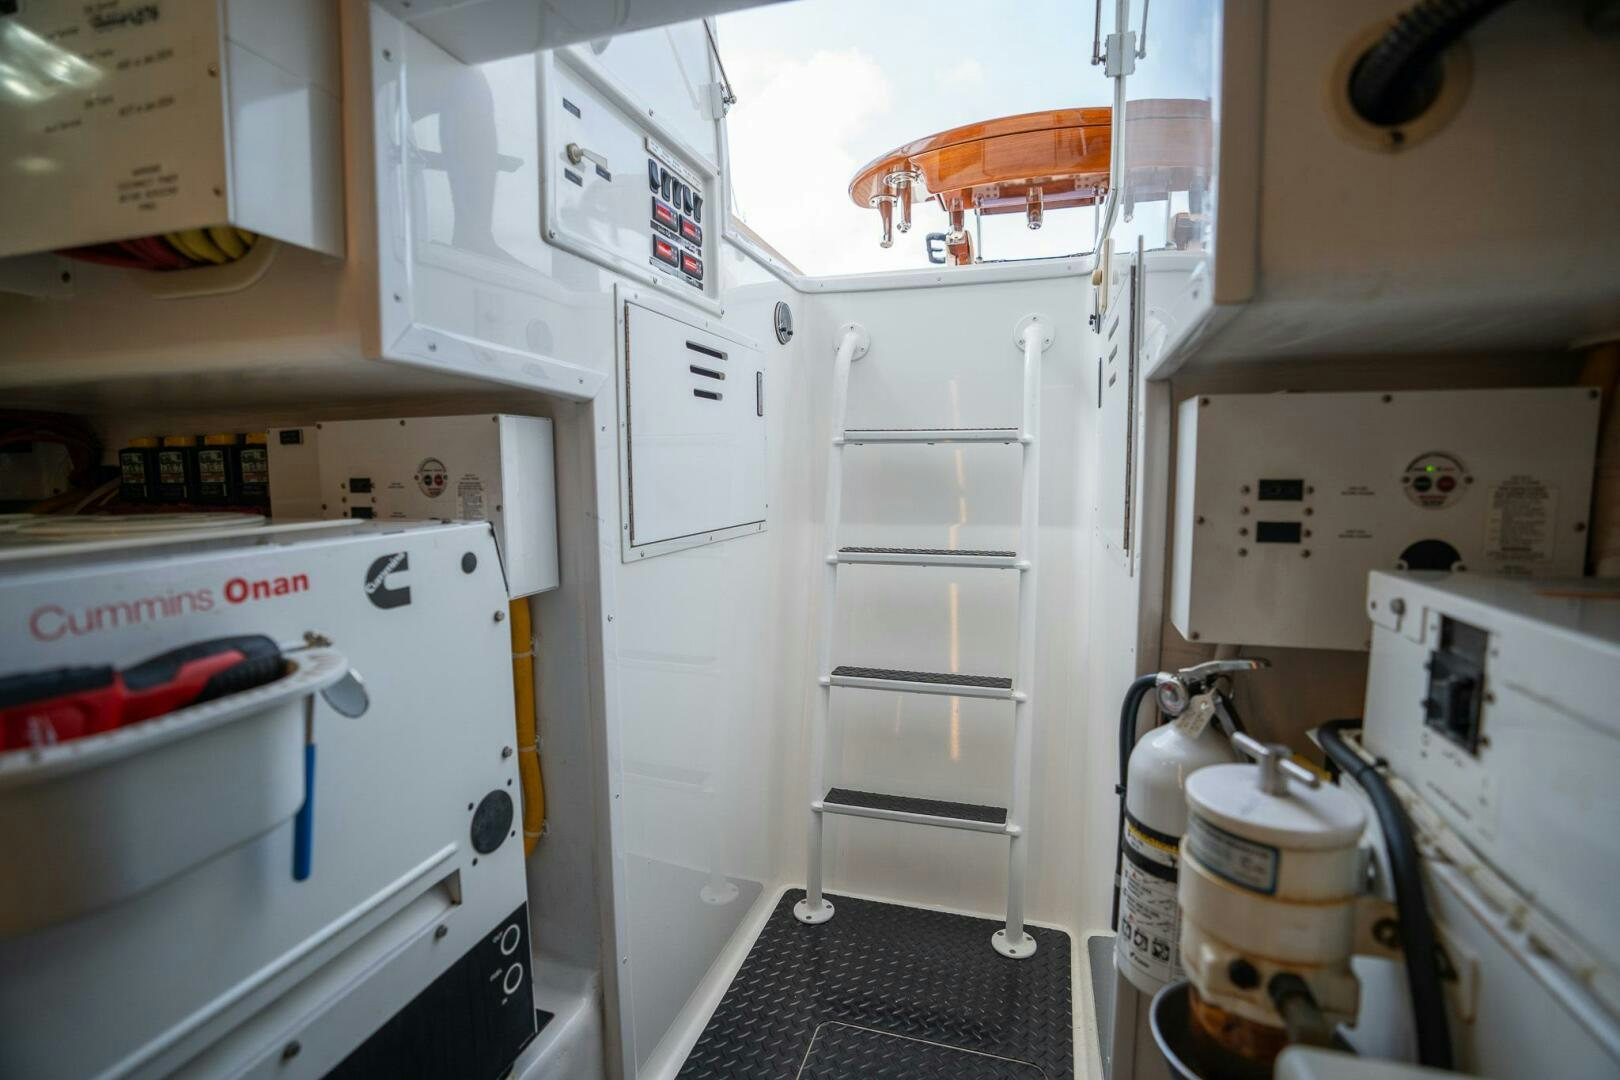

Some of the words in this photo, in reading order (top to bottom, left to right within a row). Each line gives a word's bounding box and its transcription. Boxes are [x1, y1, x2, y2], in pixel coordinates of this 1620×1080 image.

[365, 552, 406, 594] Cummins
[29, 587, 215, 642] Cummins
[223, 572, 310, 604] Onan
